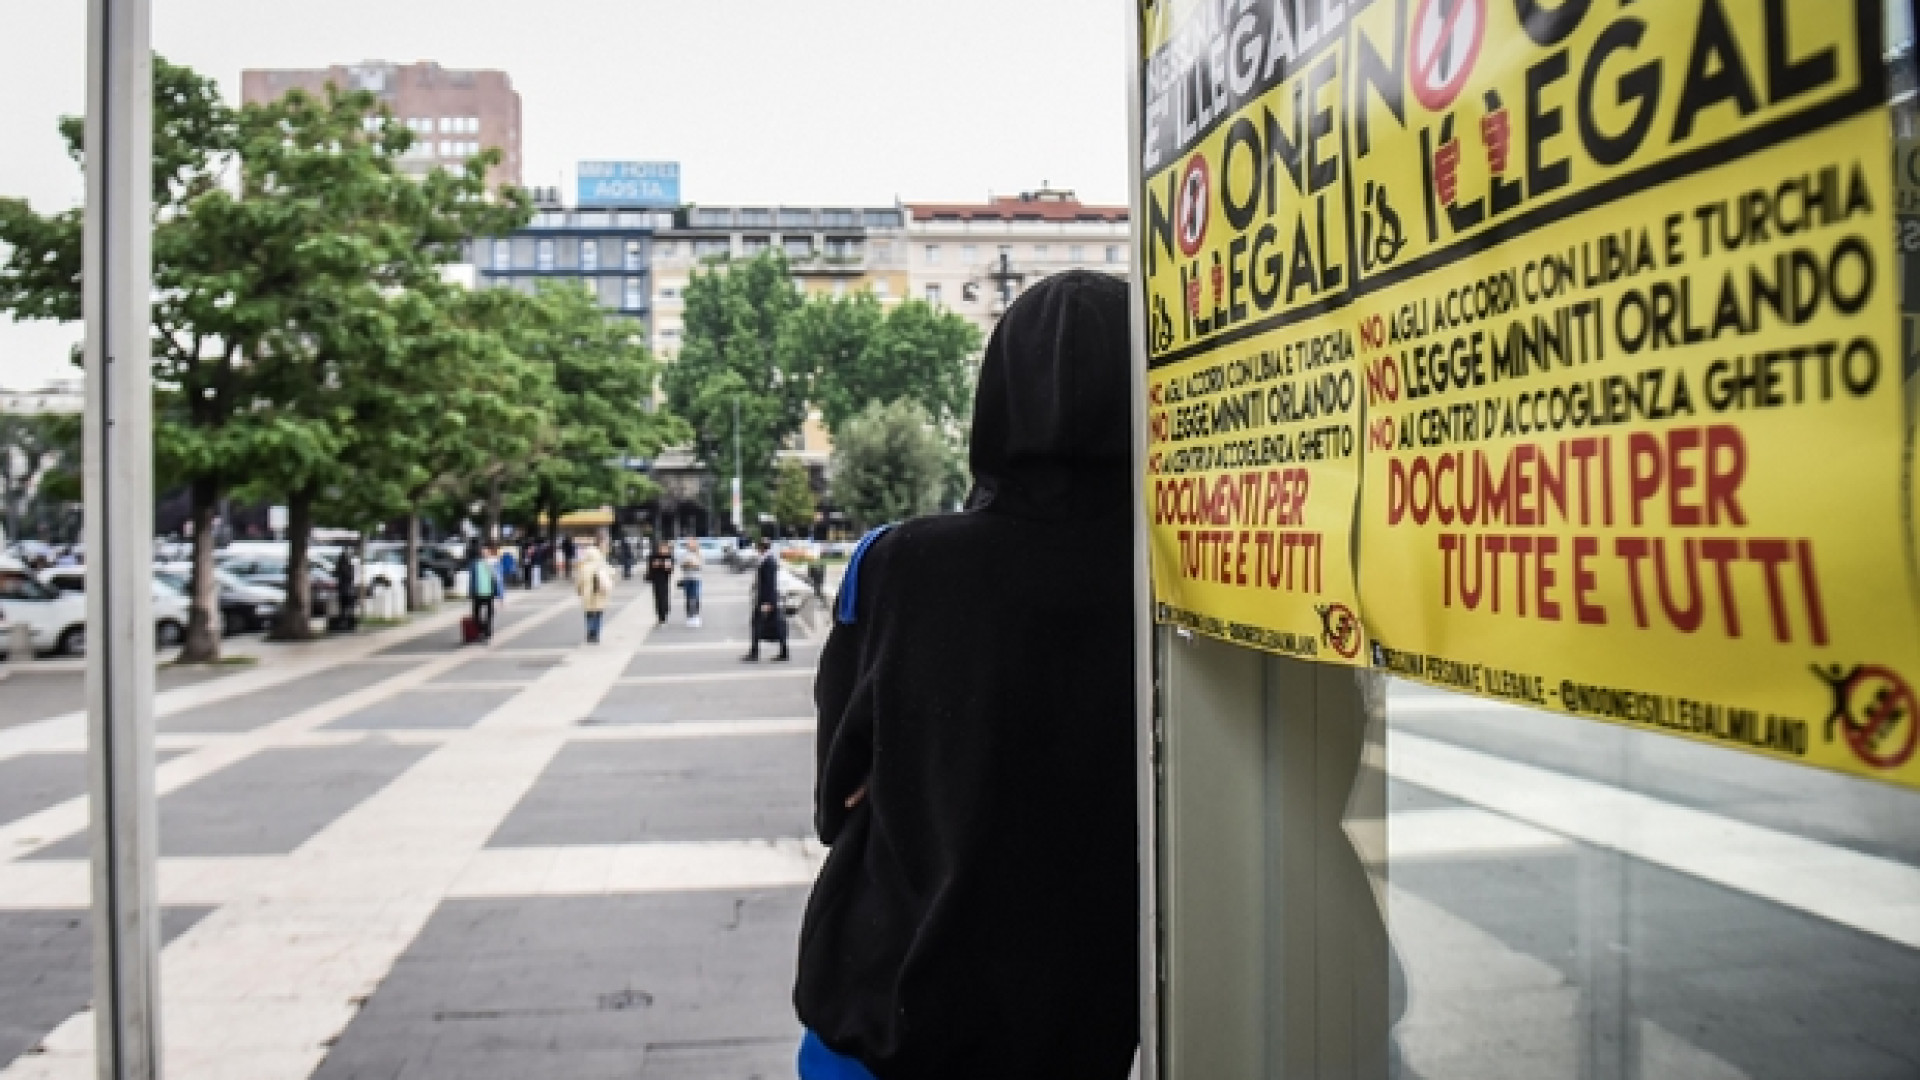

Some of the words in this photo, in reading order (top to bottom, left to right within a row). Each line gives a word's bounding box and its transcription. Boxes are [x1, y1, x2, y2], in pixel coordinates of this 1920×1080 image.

[596, 180, 662, 198] AOSTA
[1221, 50, 1342, 230] ONE
[1364, 180, 1407, 270] is
[1419, 0, 1838, 243] ILLEGAL
[1152, 292, 1175, 354] is
[1181, 196, 1342, 342] ILLEGAL
[1359, 314, 1386, 354] NO
[1389, 297, 1426, 343] AGLI
[1433, 265, 1520, 330] ACCORDI
[1522, 246, 1576, 304] CON
[1582, 225, 1655, 289] LIBIA
[1665, 213, 1683, 266] E
[1694, 160, 1873, 257] TURCHIA
[1227, 358, 1251, 388] CON
[1253, 349, 1282, 382] LIBIA
[1286, 343, 1293, 375] E
[1295, 329, 1354, 372] TURCHIA
[1365, 355, 1399, 407] NO
[1400, 328, 1486, 399] LEGGE
[1492, 296, 1603, 382] MINNITI
[1614, 234, 1875, 353] ORLANDO
[1171, 401, 1209, 440] LEGGE
[1211, 388, 1265, 434] MINNITI
[1268, 368, 1354, 423] ORLANDO
[1298, 424, 1354, 461] GHETTO
[1368, 415, 1396, 450] NO
[1399, 413, 1413, 448] AI
[1418, 397, 1478, 444] CENTRI
[1484, 366, 1694, 441] D'ACCOGLIENZA
[1705, 336, 1881, 413] GHETTO
[1155, 472, 1261, 525] DOCUMENTI
[1264, 468, 1309, 525] PER
[1388, 435, 1614, 527] DOCUMENTI
[1628, 424, 1748, 527] PER
[1177, 530, 1233, 584] TUTTE
[1236, 530, 1249, 586] E
[1254, 530, 1322, 594] TUTTI
[1438, 534, 1562, 622] TUTTE
[1572, 536, 1608, 624] E
[1615, 537, 1829, 647] TUTTI
